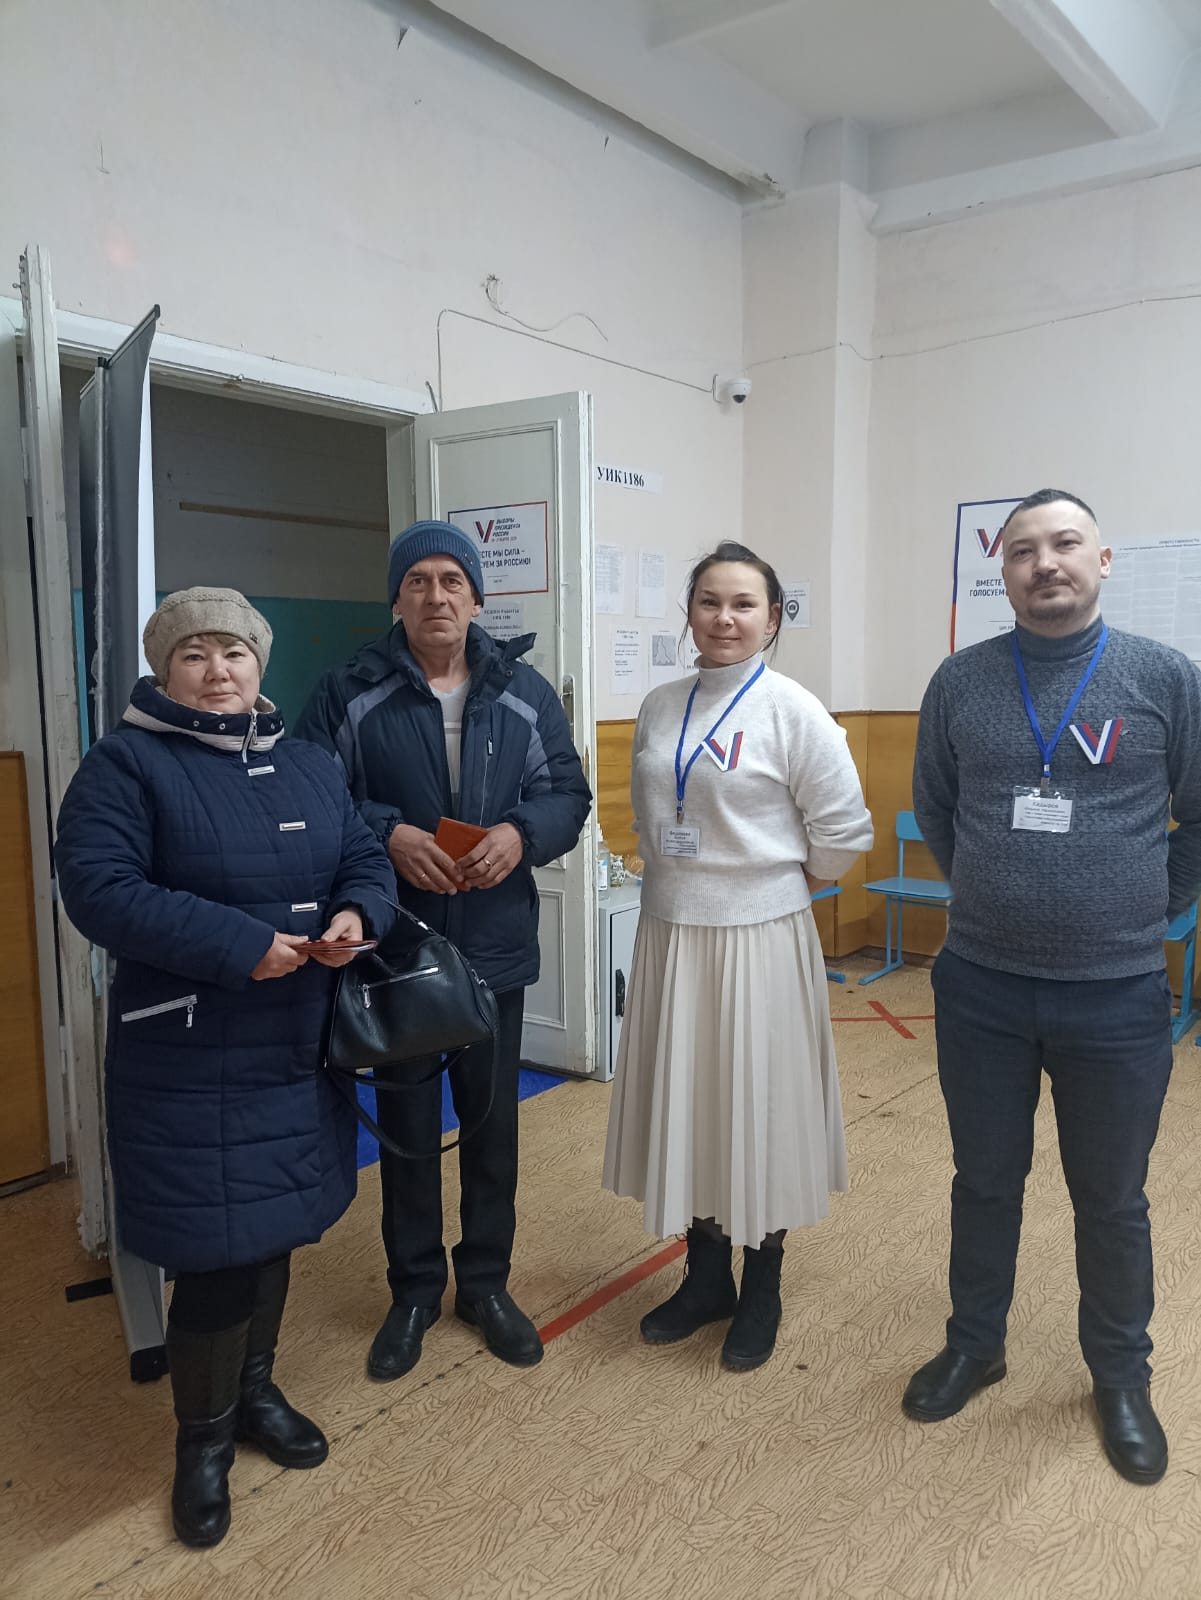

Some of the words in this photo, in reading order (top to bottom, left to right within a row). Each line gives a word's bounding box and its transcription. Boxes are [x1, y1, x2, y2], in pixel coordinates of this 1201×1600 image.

[493, 549, 504, 558] МЫ
[504, 547, 520, 557] СИЛА
[496, 559, 504, 568] ЗА
[976, 578, 1002, 586] ВМЕСТЕ
[969, 588, 1005, 596] ГОЛОСУЕМ
